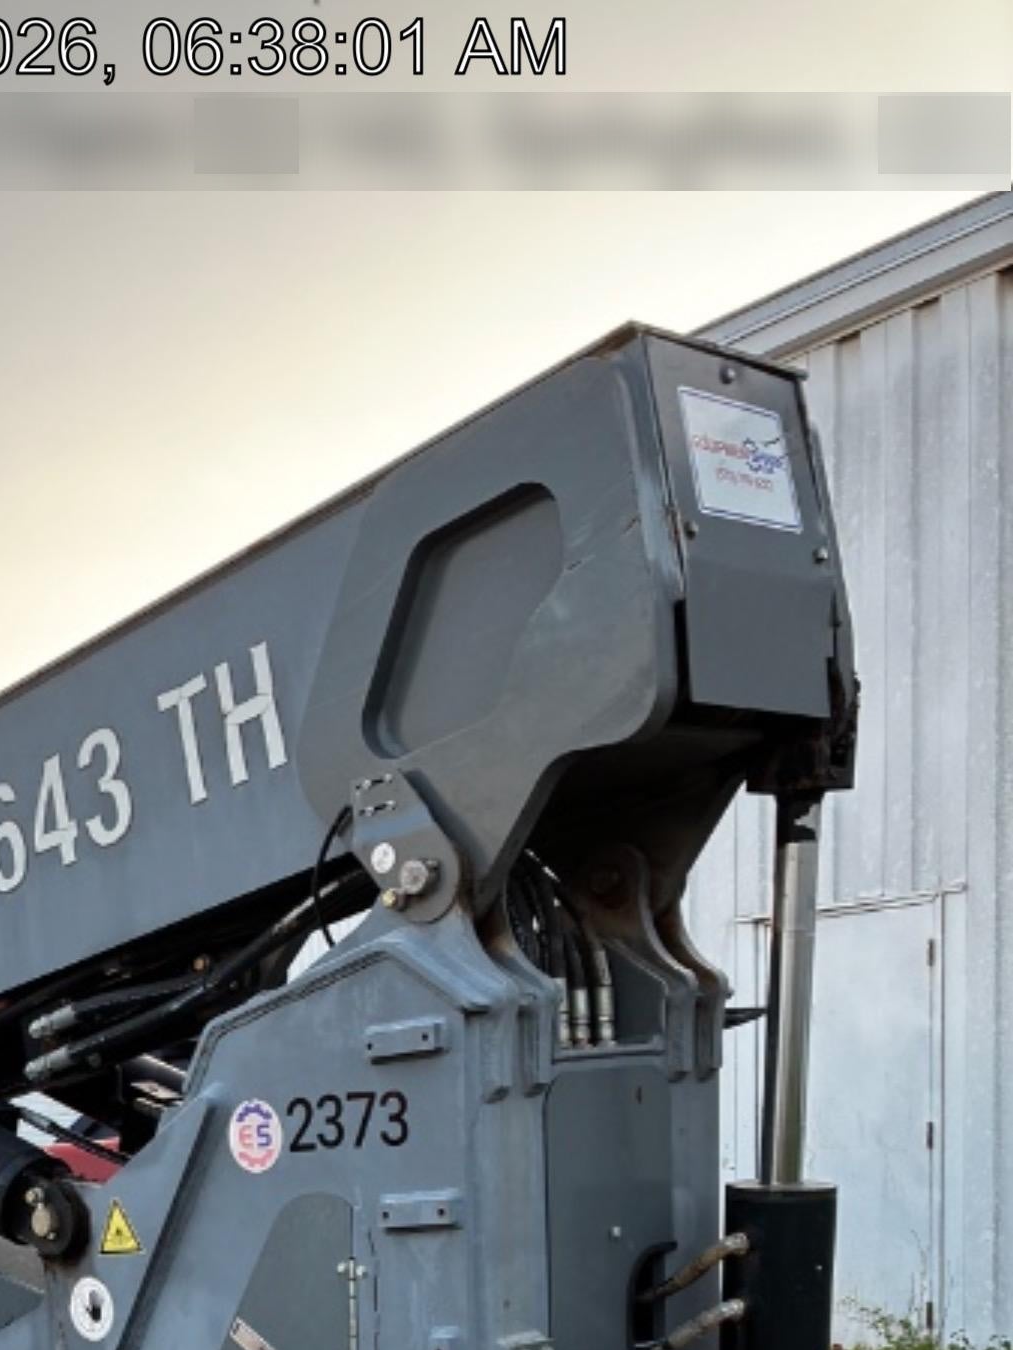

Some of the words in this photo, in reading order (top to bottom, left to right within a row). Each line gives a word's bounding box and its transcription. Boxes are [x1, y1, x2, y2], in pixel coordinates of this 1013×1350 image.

[157, 641, 288, 806] TH
[238, 1123, 273, 1148] ES
[287, 1090, 409, 1153] 2373
